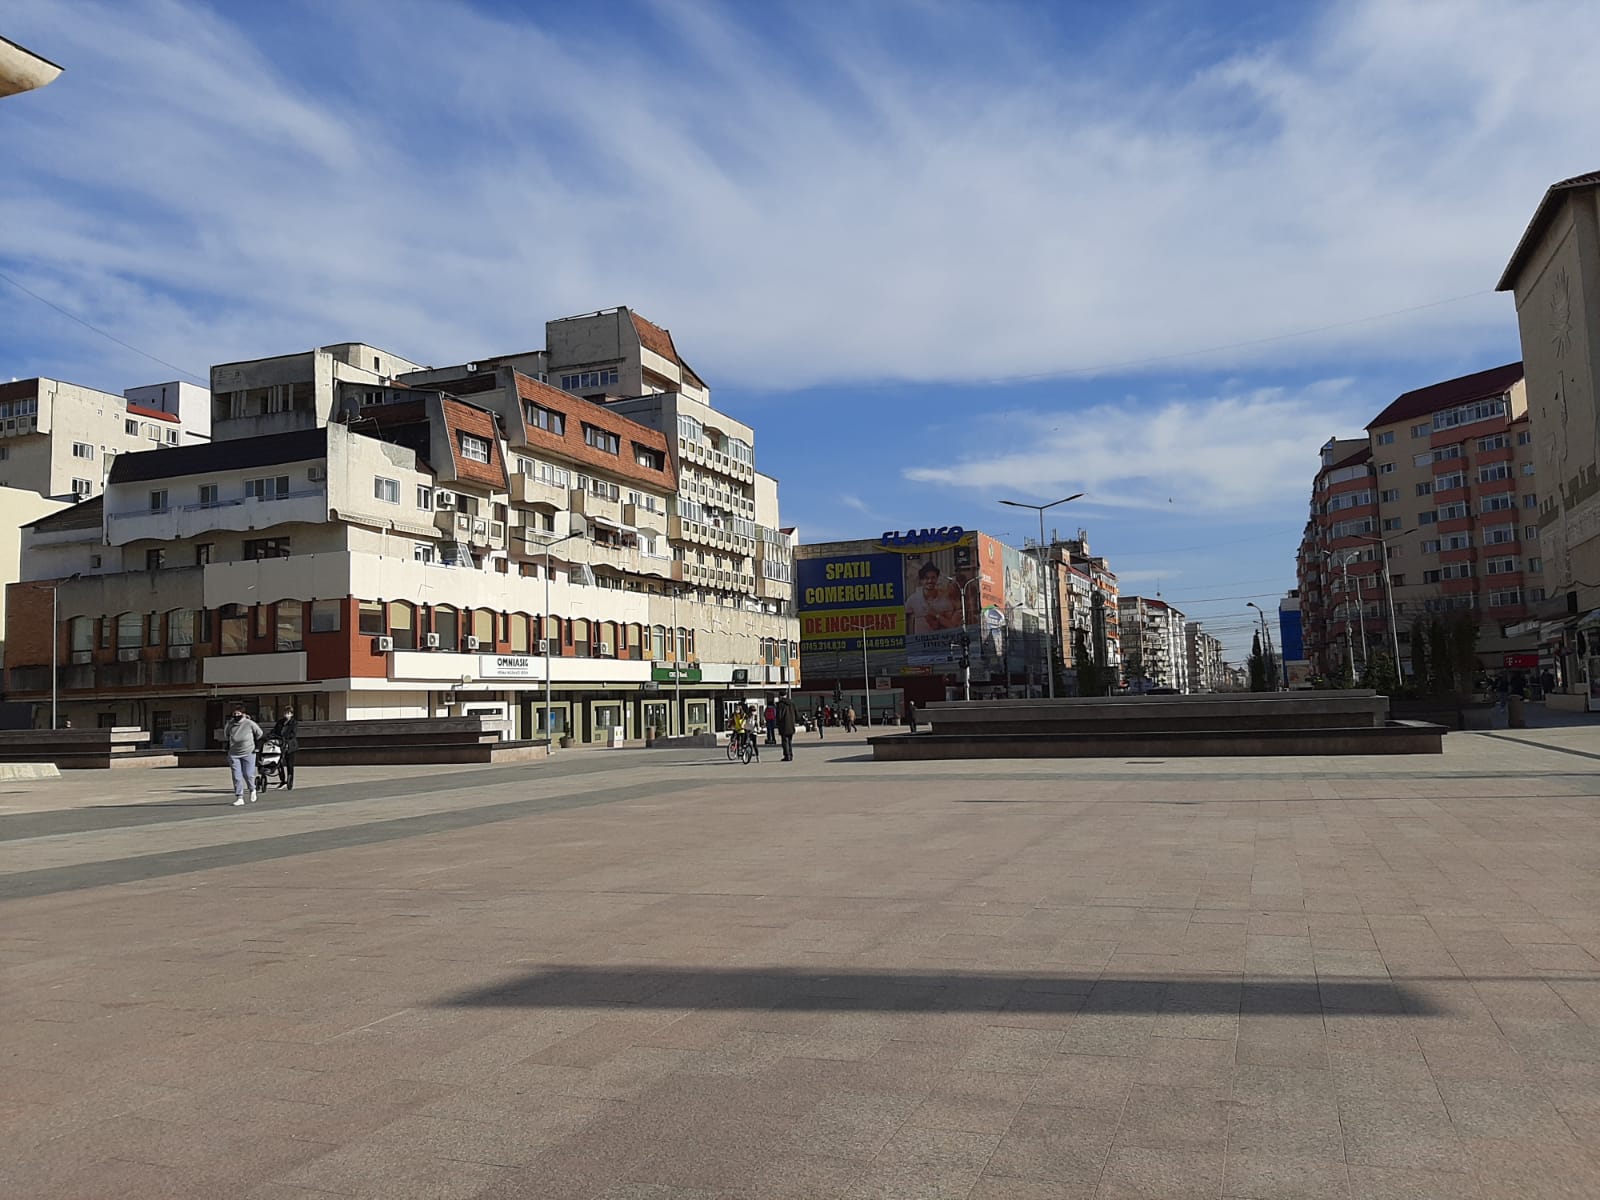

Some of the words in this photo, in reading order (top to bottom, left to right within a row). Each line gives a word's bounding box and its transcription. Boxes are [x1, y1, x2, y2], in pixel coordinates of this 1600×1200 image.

[881, 526, 964, 547] FLANCO
[826, 561, 870, 580] SPATII
[806, 583, 894, 604] COMERCIALE
[806, 618, 822, 634] DE
[826, 614, 897, 633] INCHIRIAT
[497, 657, 529, 667] OMNIASIG
